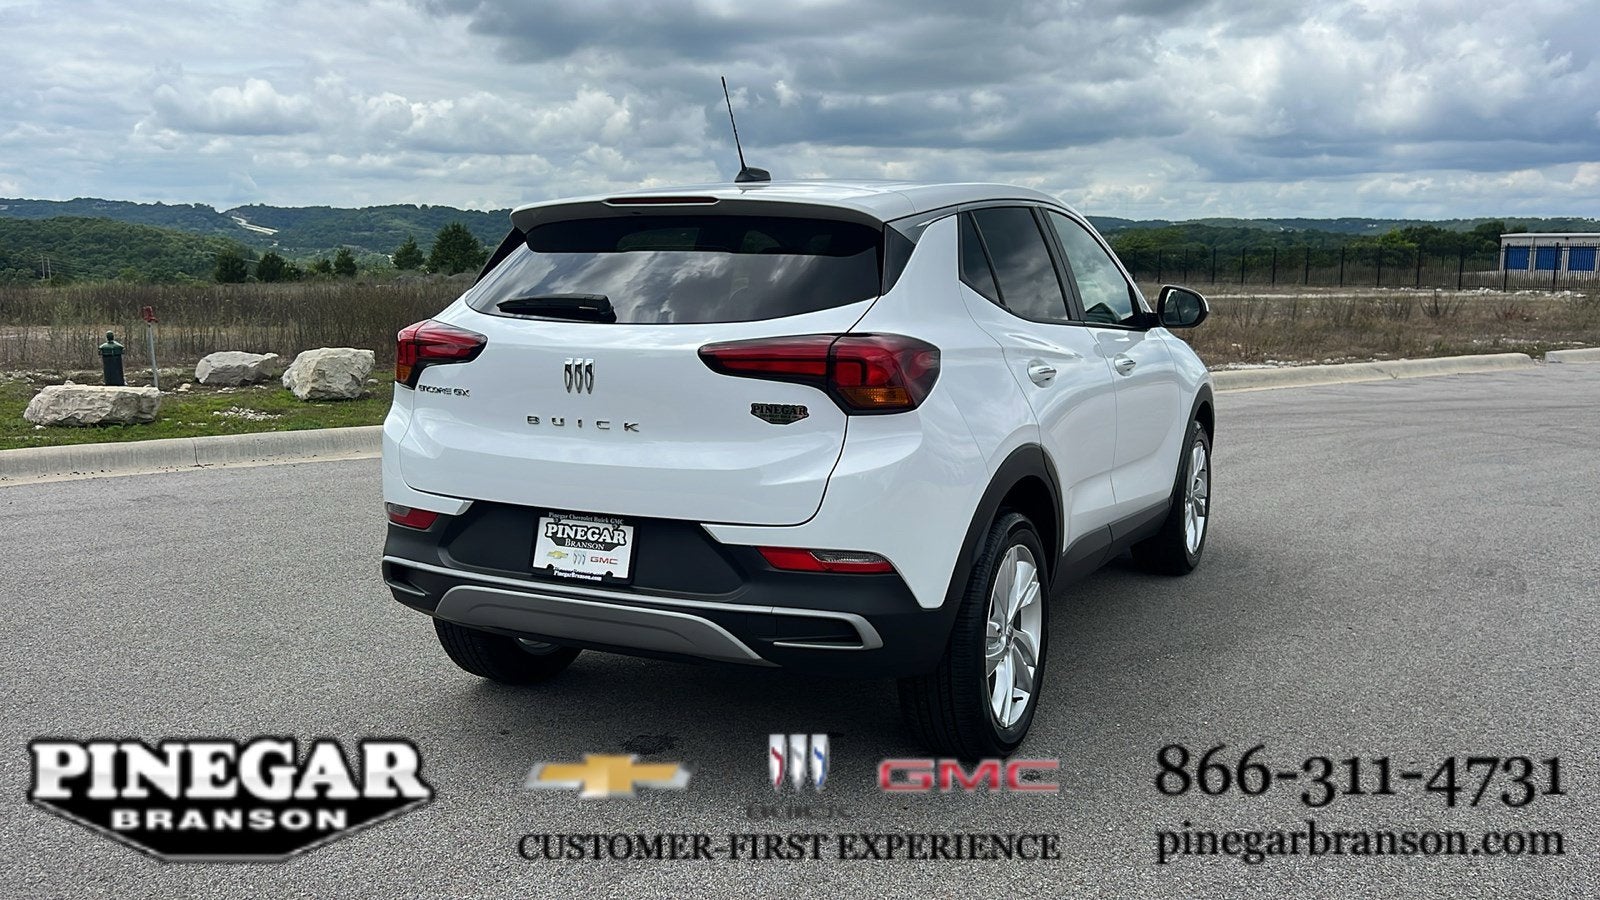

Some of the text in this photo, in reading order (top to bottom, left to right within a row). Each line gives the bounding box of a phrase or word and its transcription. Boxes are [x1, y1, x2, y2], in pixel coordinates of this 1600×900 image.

[418, 384, 470, 397] ENCORE GX
[752, 404, 808, 416] PINEGAR
[527, 415, 640, 433] BUICK
[548, 512, 569, 521] Pinegar
[569, 514, 593, 522] Chevrolet
[546, 523, 626, 544] PINEGAR
[590, 556, 618, 565] GMC
